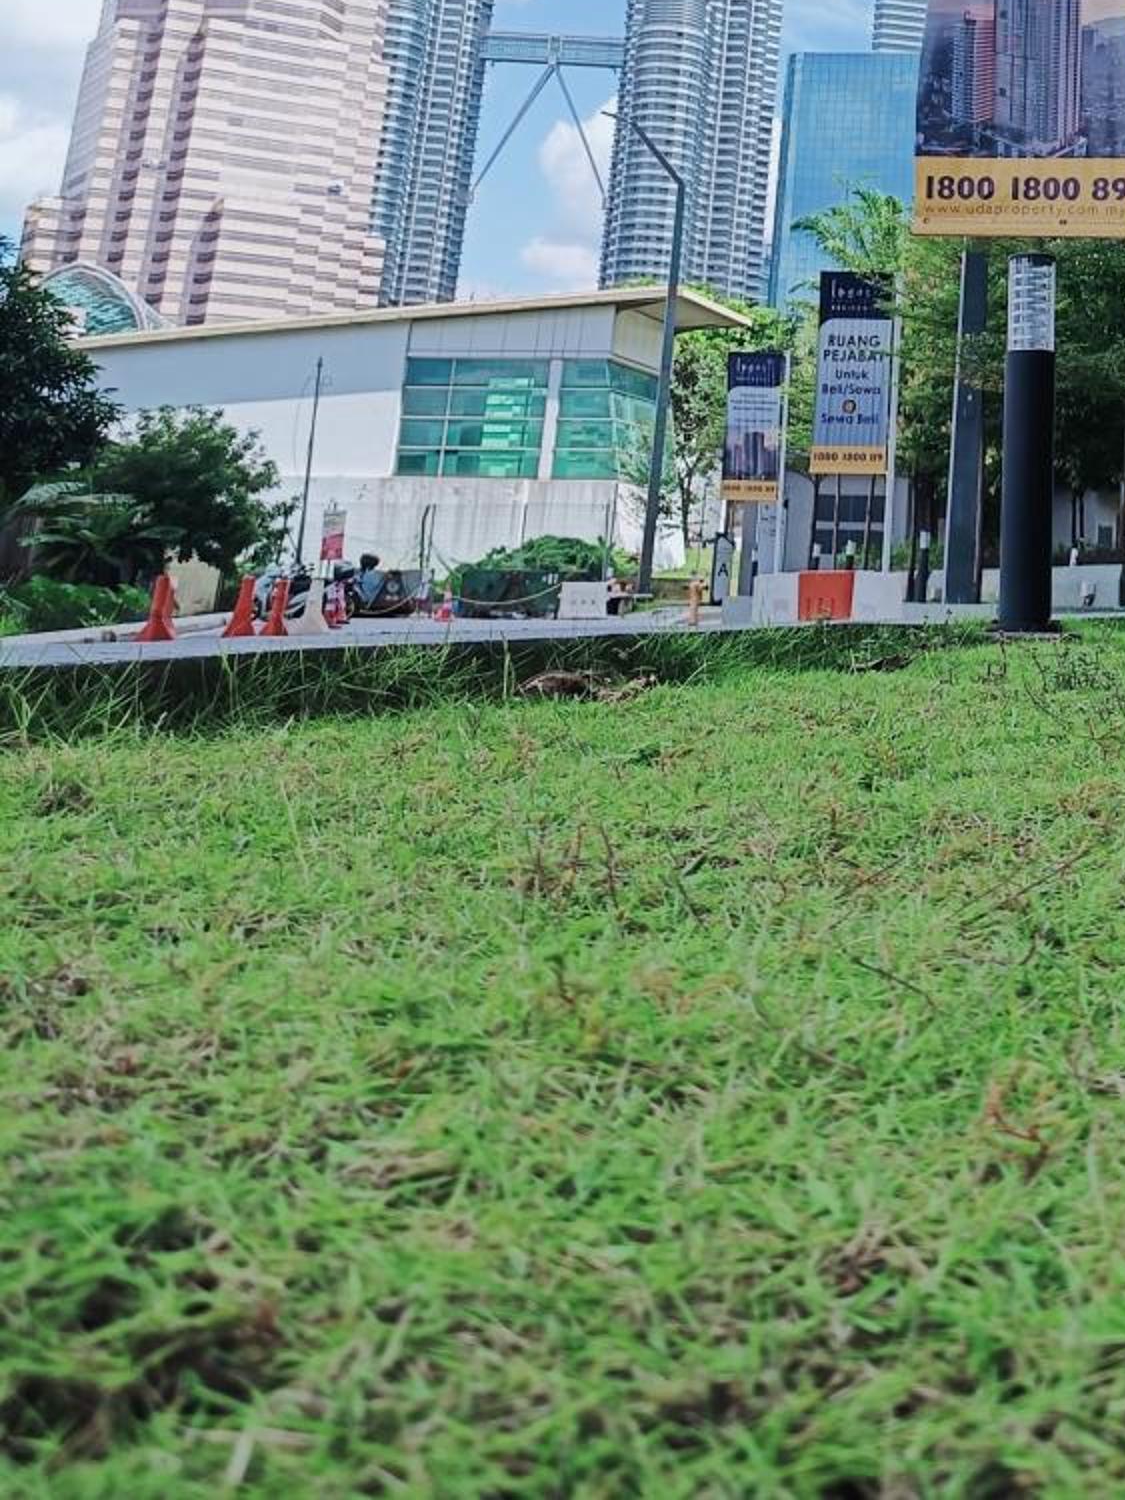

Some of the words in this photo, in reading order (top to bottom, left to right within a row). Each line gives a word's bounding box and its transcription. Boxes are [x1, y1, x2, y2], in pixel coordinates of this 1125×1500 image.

[925, 175, 995, 200] 1800
[1011, 176, 1081, 200] 1800
[828, 335, 881, 348] RUANG
[835, 369, 868, 379] Untuk
